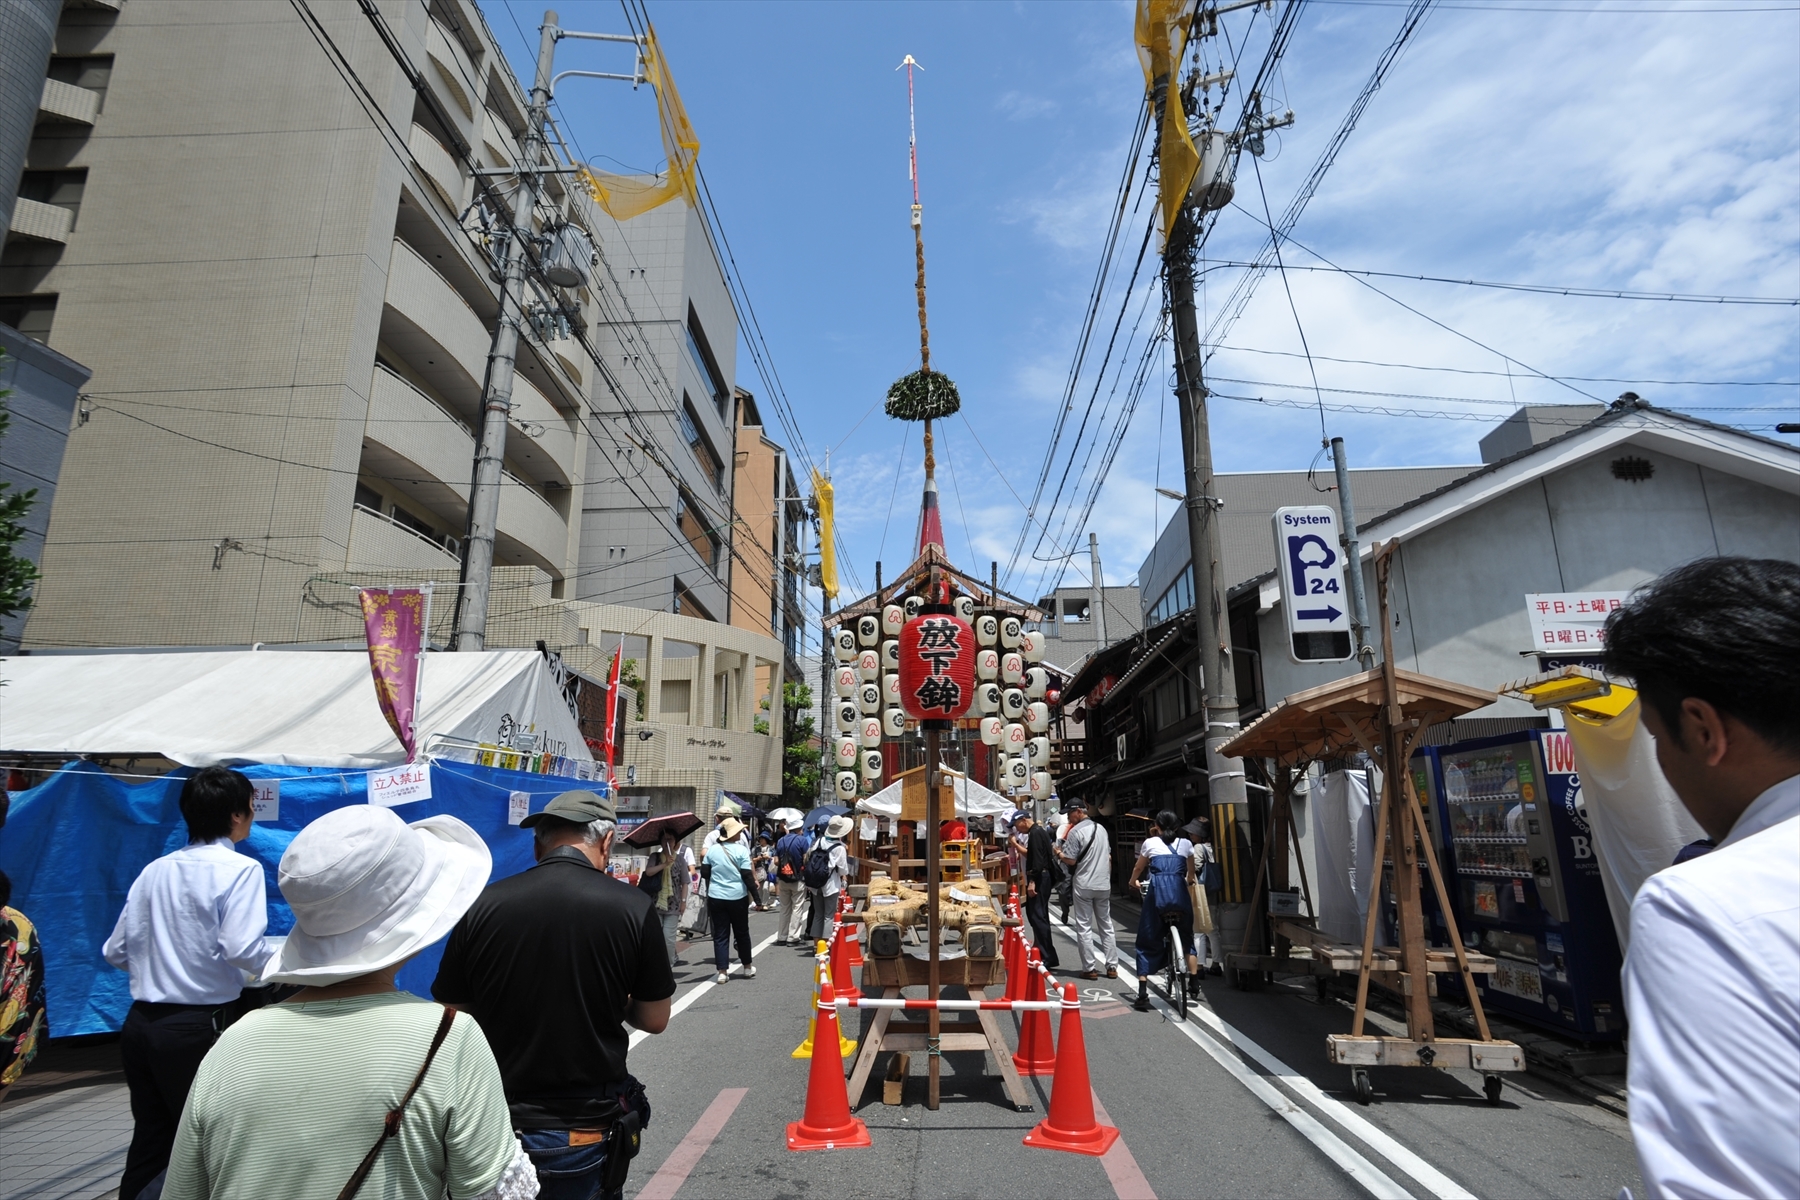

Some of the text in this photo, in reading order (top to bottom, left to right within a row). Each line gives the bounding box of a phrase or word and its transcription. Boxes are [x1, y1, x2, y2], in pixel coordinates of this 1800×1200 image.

[1284, 514, 1331, 527] System
[1310, 578, 1340, 594] 24
[914, 617, 963, 715] 放下鉾
[1546, 734, 1578, 772] 100
[374, 770, 426, 790] 立入禁止
[252, 787, 274, 801] 禁止
